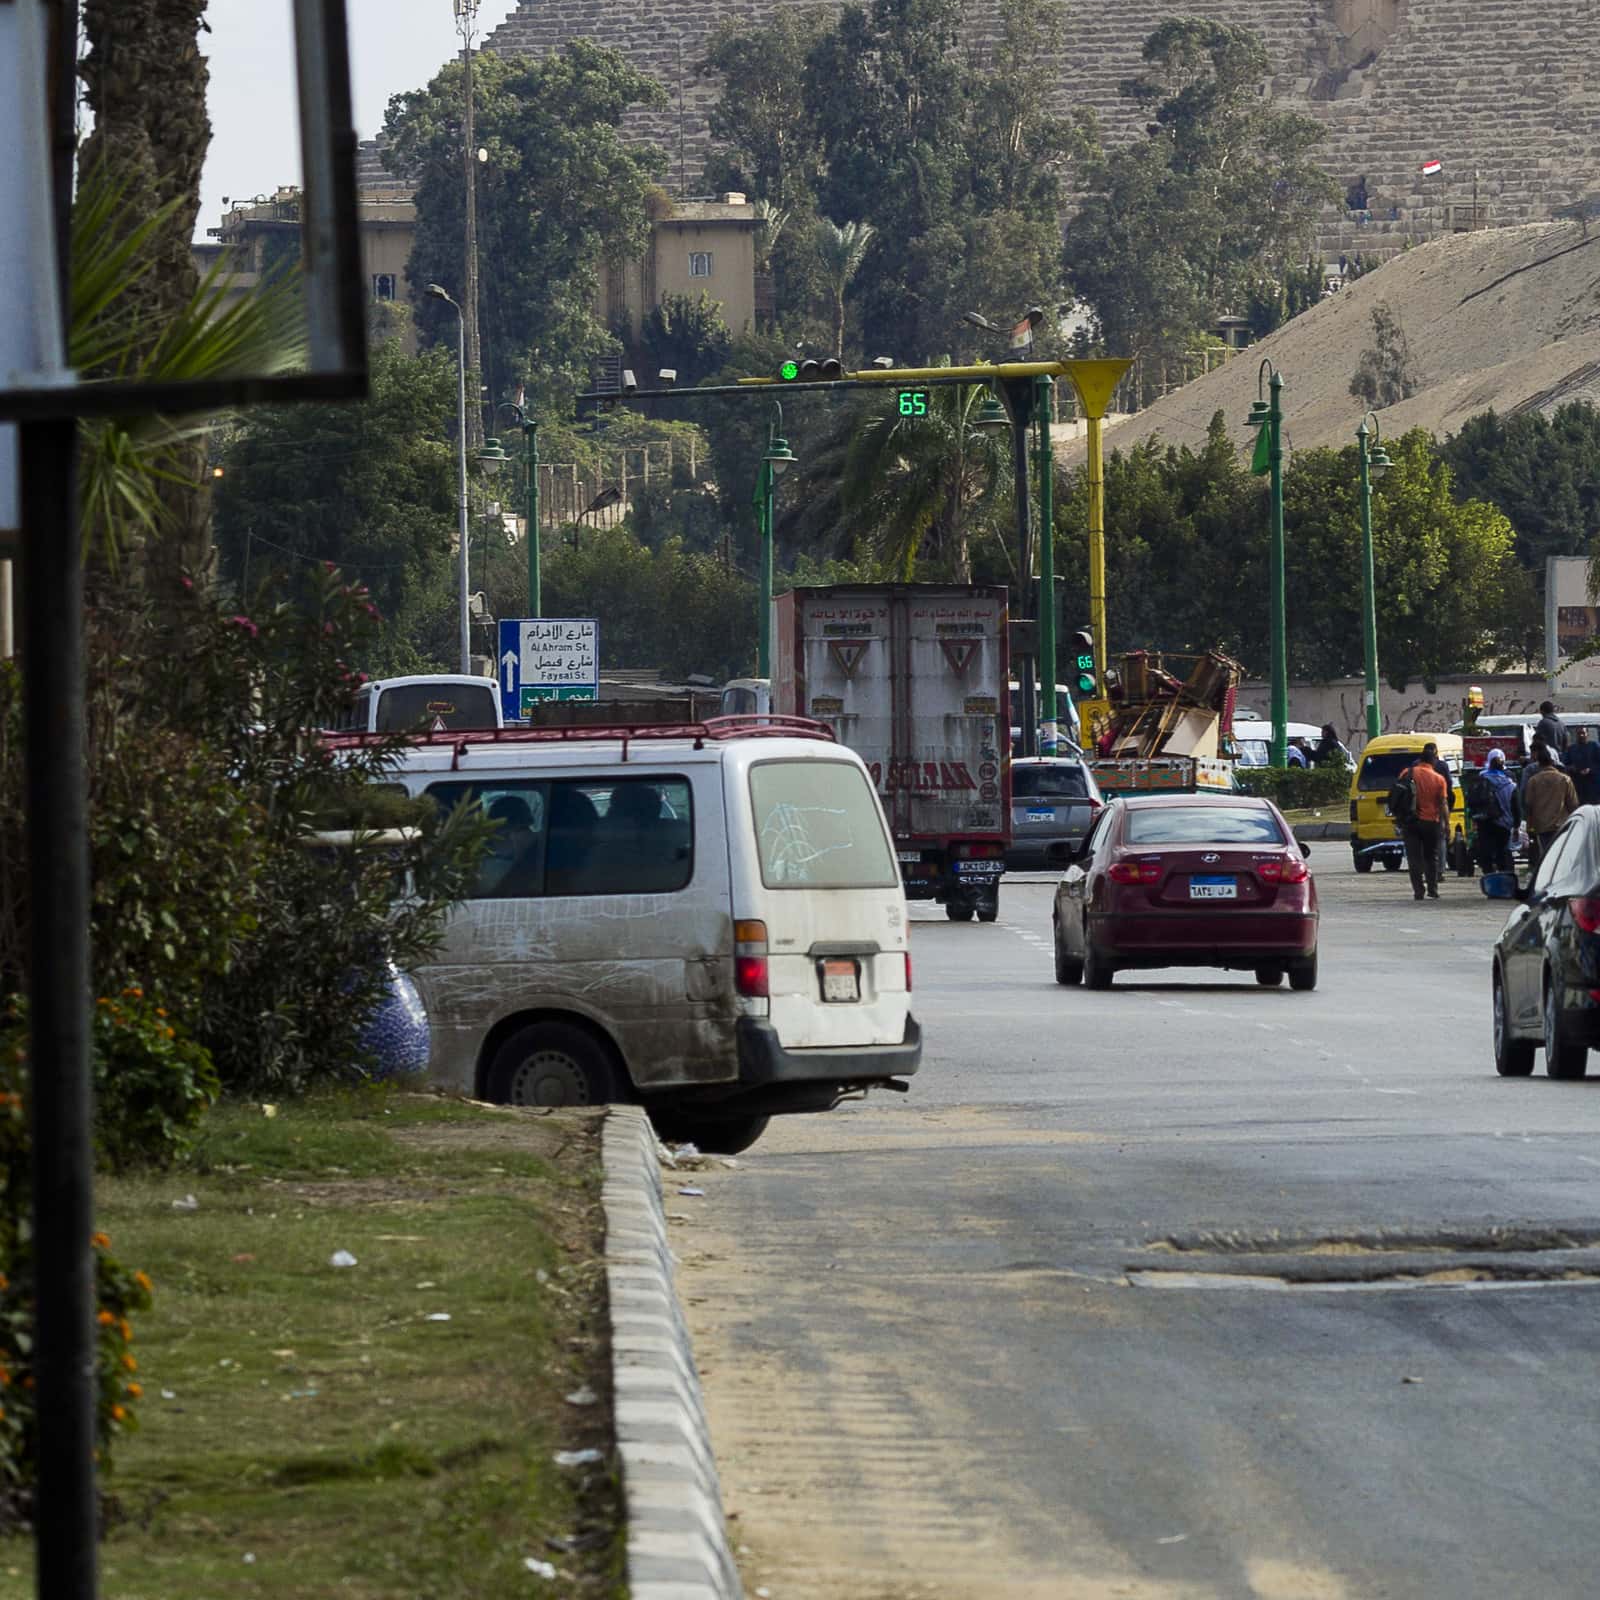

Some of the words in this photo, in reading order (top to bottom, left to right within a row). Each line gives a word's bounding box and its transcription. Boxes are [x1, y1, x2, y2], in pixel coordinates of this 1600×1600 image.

[900, 392, 926, 415] 65
[566, 624, 594, 640] شارع
[542, 643, 573, 652] Ahram
[567, 654, 593, 670] شارع
